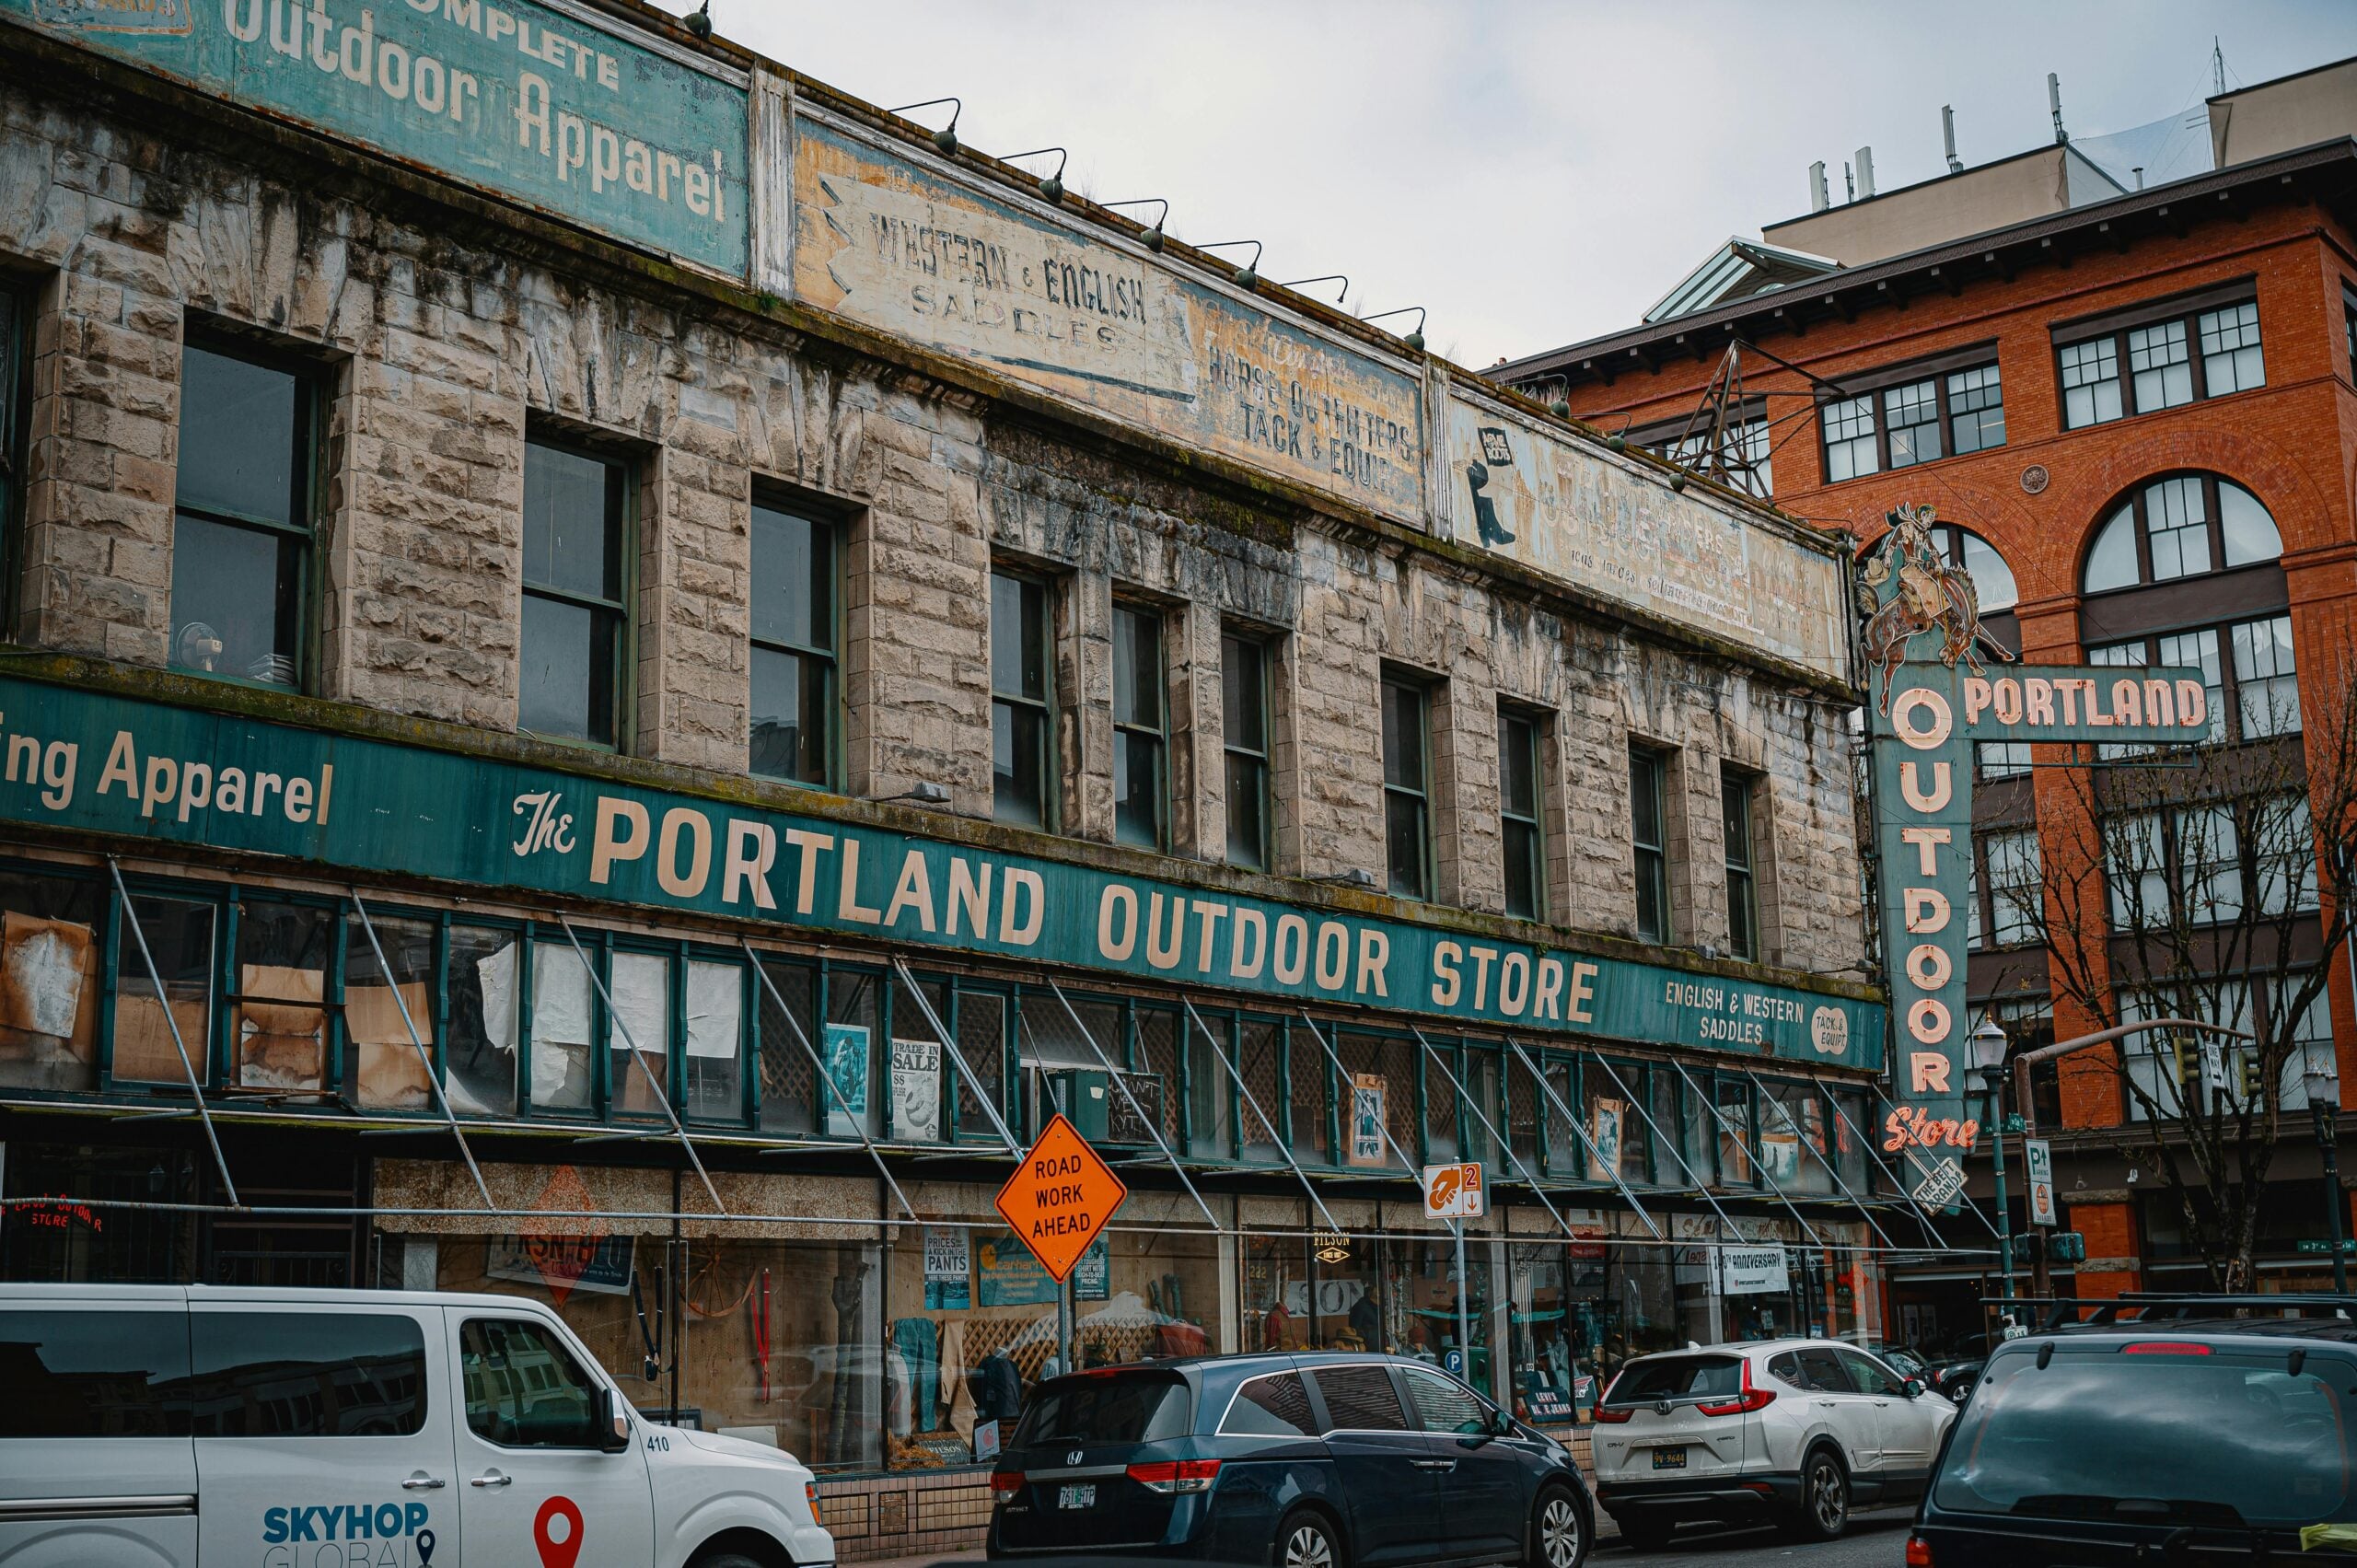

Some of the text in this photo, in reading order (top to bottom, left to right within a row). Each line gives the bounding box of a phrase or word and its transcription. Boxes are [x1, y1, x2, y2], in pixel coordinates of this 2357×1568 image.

[514, 72, 725, 222] Apparel
[869, 212, 1146, 325] WESTERN & ENGLISH
[911, 284, 1120, 354] SADDLES
[1209, 345, 1280, 411] HORSE
[1240, 401, 1303, 459] TACK
[1311, 436, 1321, 459] &
[1485, 447, 1510, 460] BOOTS
[1964, 678, 2206, 727] PORTLAND
[0, 712, 333, 825] ng Apparel
[1892, 687, 1952, 1094] OUTDOOR
[513, 790, 1598, 1023] The PORTLAND OUTDOOR STORE
[1666, 981, 1804, 1023] ENGLISH & WESTERN
[1700, 1016, 1762, 1045] SADDLES
[1817, 1016, 1843, 1031] TACK &
[893, 1042, 938, 1055] TRADE IN
[2209, 1046, 2218, 1058] ONE
[893, 1052, 938, 1072] SALE
[2211, 1058, 2219, 1068] WAY
[1884, 1106, 1980, 1152] Store
[1035, 1155, 1082, 1179] ROAD
[1465, 1166, 1477, 1187] 2
[1933, 1162, 1954, 1186] BET
[1036, 1184, 1084, 1208] WORK
[1916, 1181, 1936, 1202] THE
[32, 1214, 69, 1227] STORE
[1032, 1213, 1091, 1238] AHEAD
[927, 1237, 956, 1248] PRICES
[1313, 1231, 1350, 1246] FILSON
[928, 1256, 967, 1271] PANTS
[1733, 1252, 1782, 1270] ANNIVERSARY
[1451, 1354, 1460, 1370] P
[1550, 1403, 1572, 1414] JEANS
[646, 1435, 670, 1453] 410
[1061, 1488, 1095, 1504] 761 HTP
[262, 1503, 429, 1543] SKYHOP
